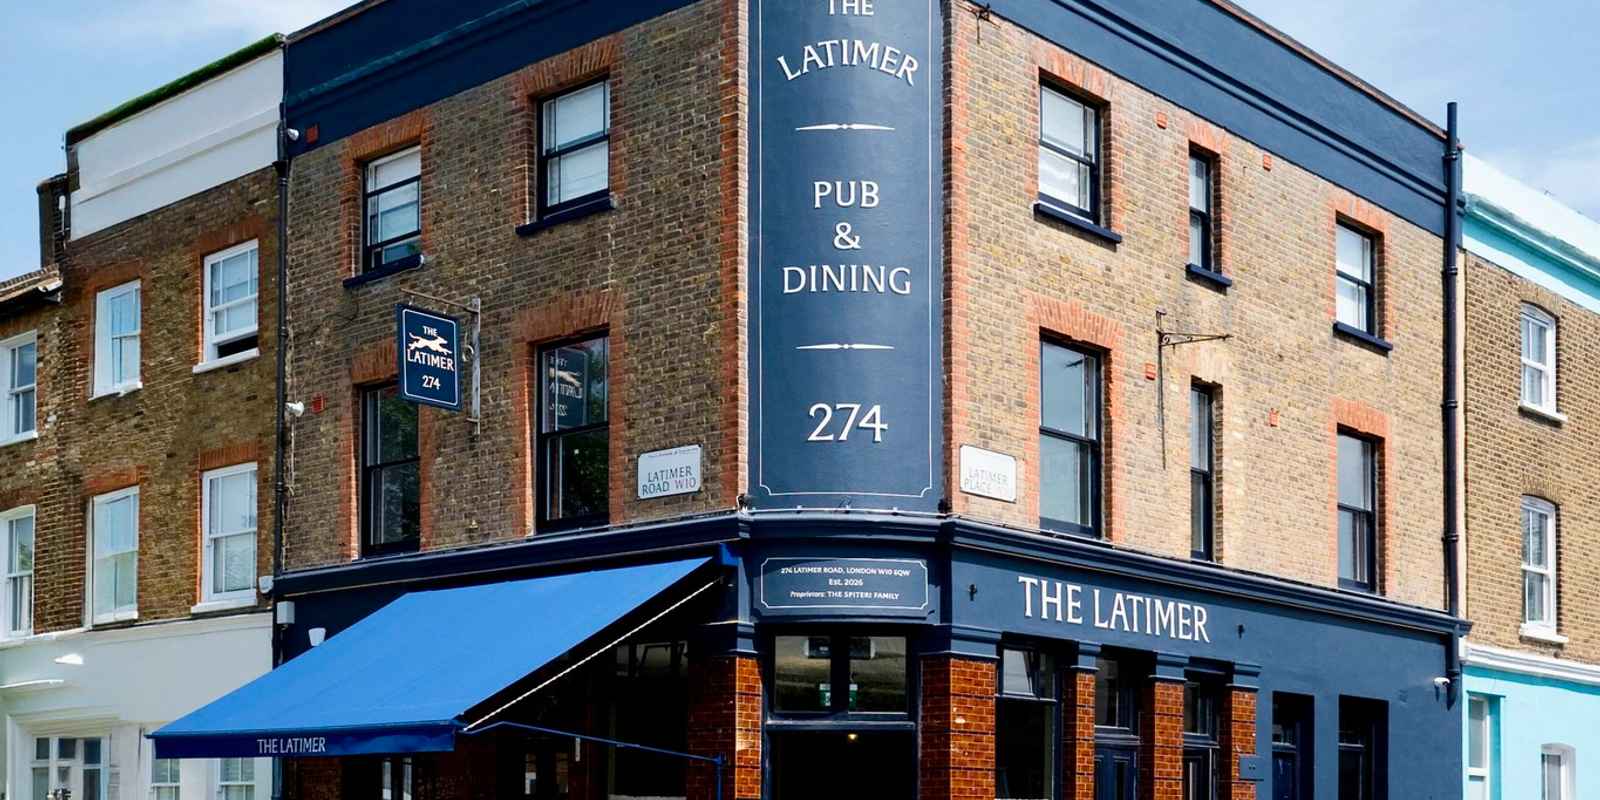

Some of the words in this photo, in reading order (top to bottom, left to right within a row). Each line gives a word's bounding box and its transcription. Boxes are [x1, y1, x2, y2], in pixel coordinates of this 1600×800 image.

[828, 0, 874, 16] THE
[777, 39, 919, 86] LATIMER
[813, 180, 880, 209] PUB
[833, 222, 862, 250] &
[782, 264, 912, 295] DINING
[422, 325, 438, 337] THE
[407, 349, 455, 372] LATIMER
[422, 375, 441, 391] 274
[807, 402, 889, 443] 274
[647, 465, 693, 483] LATIMER
[641, 481, 670, 497] ROAD
[846, 567, 877, 575] LONDON
[827, 591, 842, 599] THE
[873, 592, 900, 600] FAMILY
[1018, 575, 1084, 625] THE
[1093, 588, 1211, 644] LATIMER
[256, 737, 279, 754] THE
[280, 736, 326, 754] LATIMER
